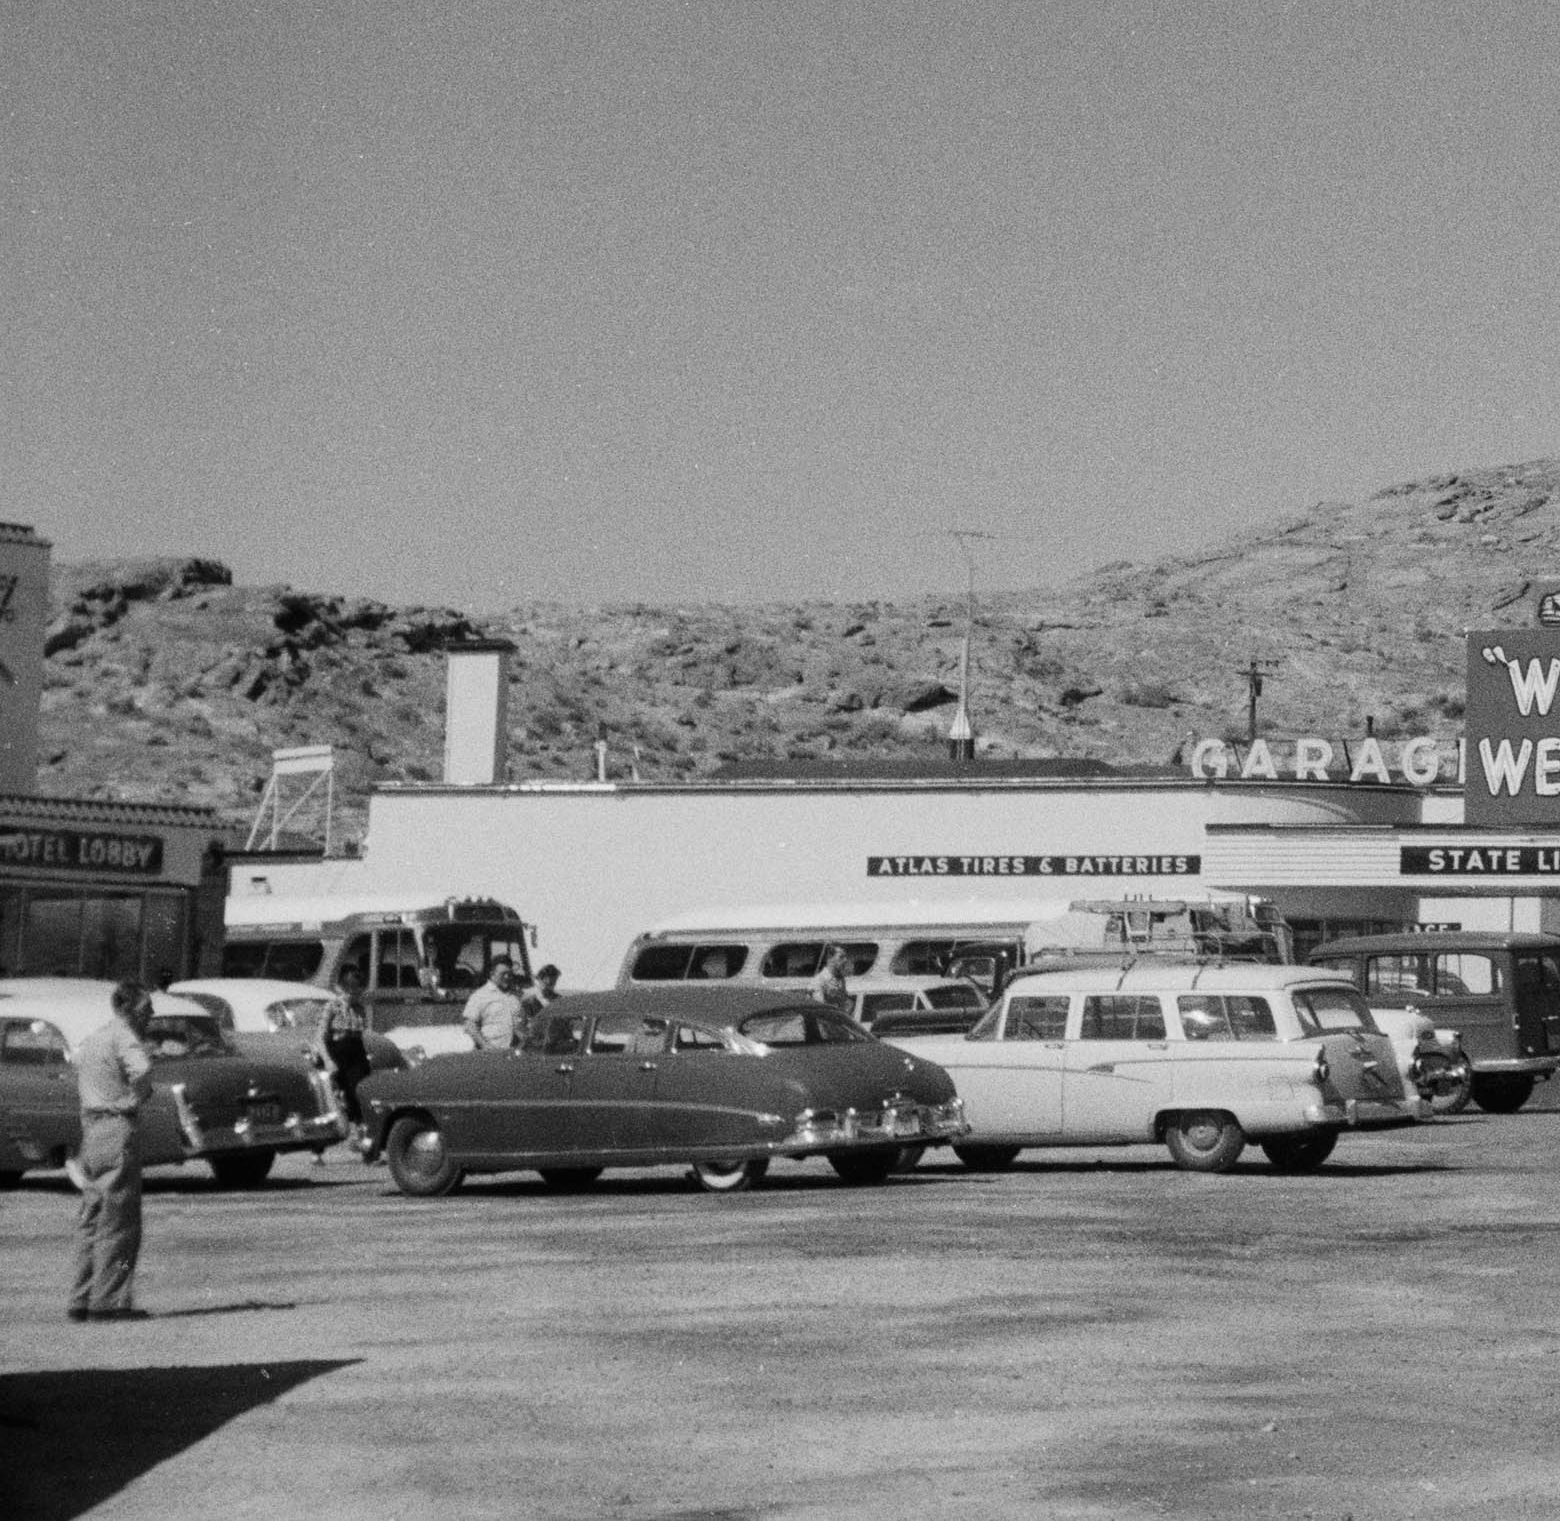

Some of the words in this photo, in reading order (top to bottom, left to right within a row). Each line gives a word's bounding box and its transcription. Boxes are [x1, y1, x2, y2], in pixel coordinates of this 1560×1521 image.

[1191, 736, 1466, 787] GARAG
[79, 837, 153, 869] LOBBY
[878, 857, 949, 875] ATLAS
[960, 857, 1025, 874] TIRES
[1039, 857, 1053, 874] &
[1065, 856, 1189, 875] BATTERIES
[1429, 849, 1521, 871] STATE
